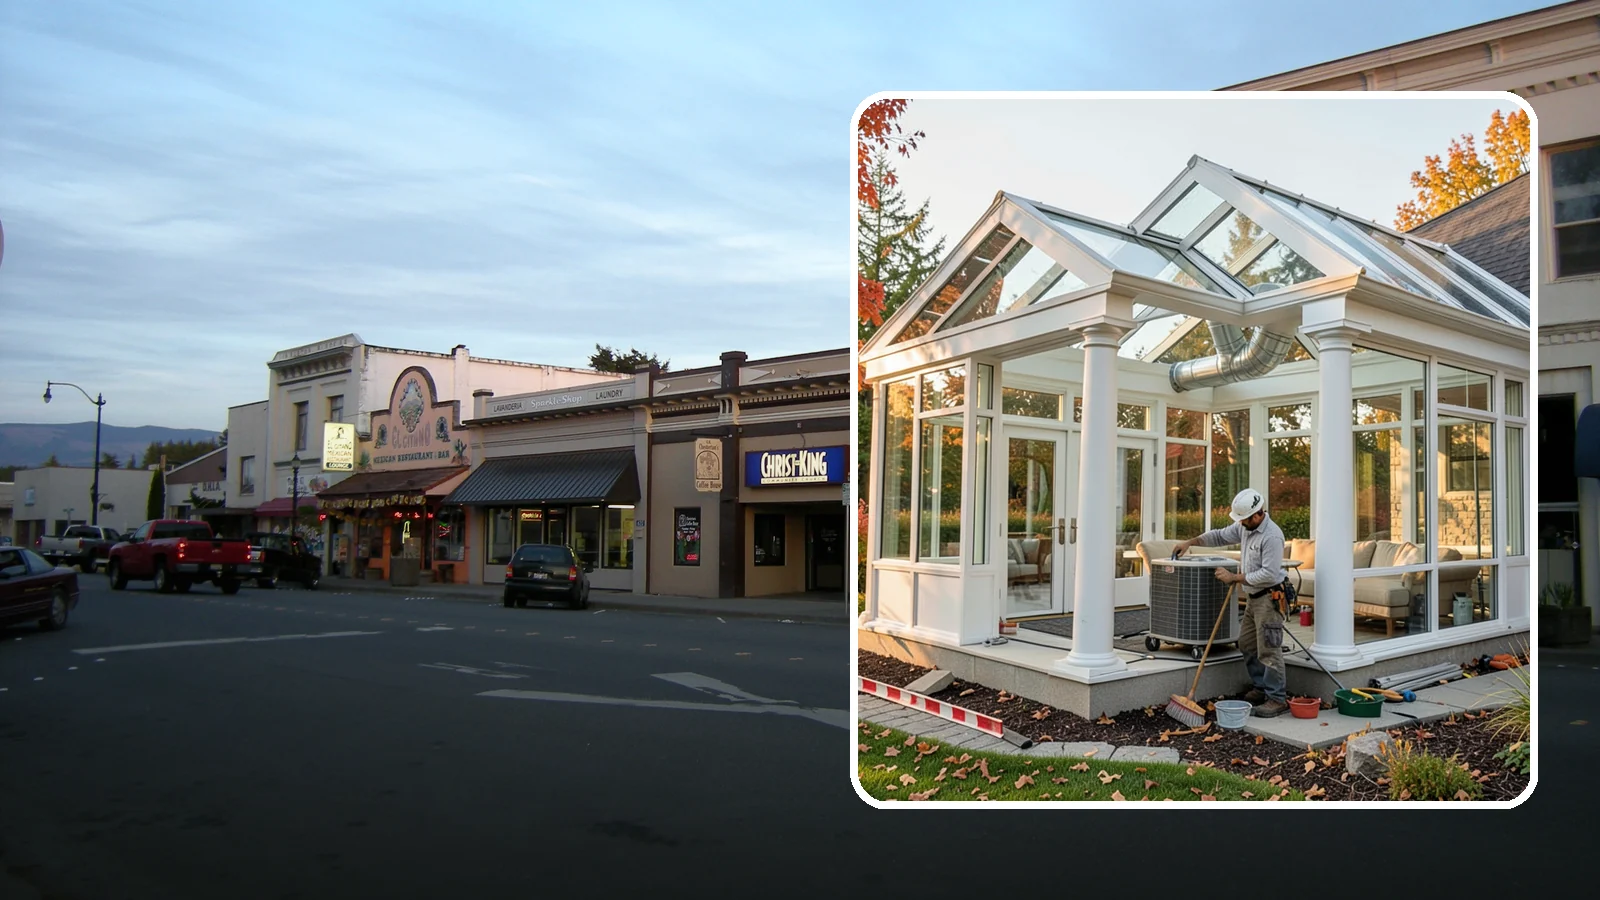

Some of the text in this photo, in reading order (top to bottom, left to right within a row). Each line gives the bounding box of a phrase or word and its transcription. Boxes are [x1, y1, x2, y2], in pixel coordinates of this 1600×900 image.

[595, 389, 623, 399] LAUNDRY
[493, 402, 523, 413] LAVANDERIA
[374, 455, 395, 463] MEXICAN
[397, 451, 433, 462] RESTAURANT
[437, 450, 450, 459] BAR
[761, 450, 827, 478] CHRIST KING
